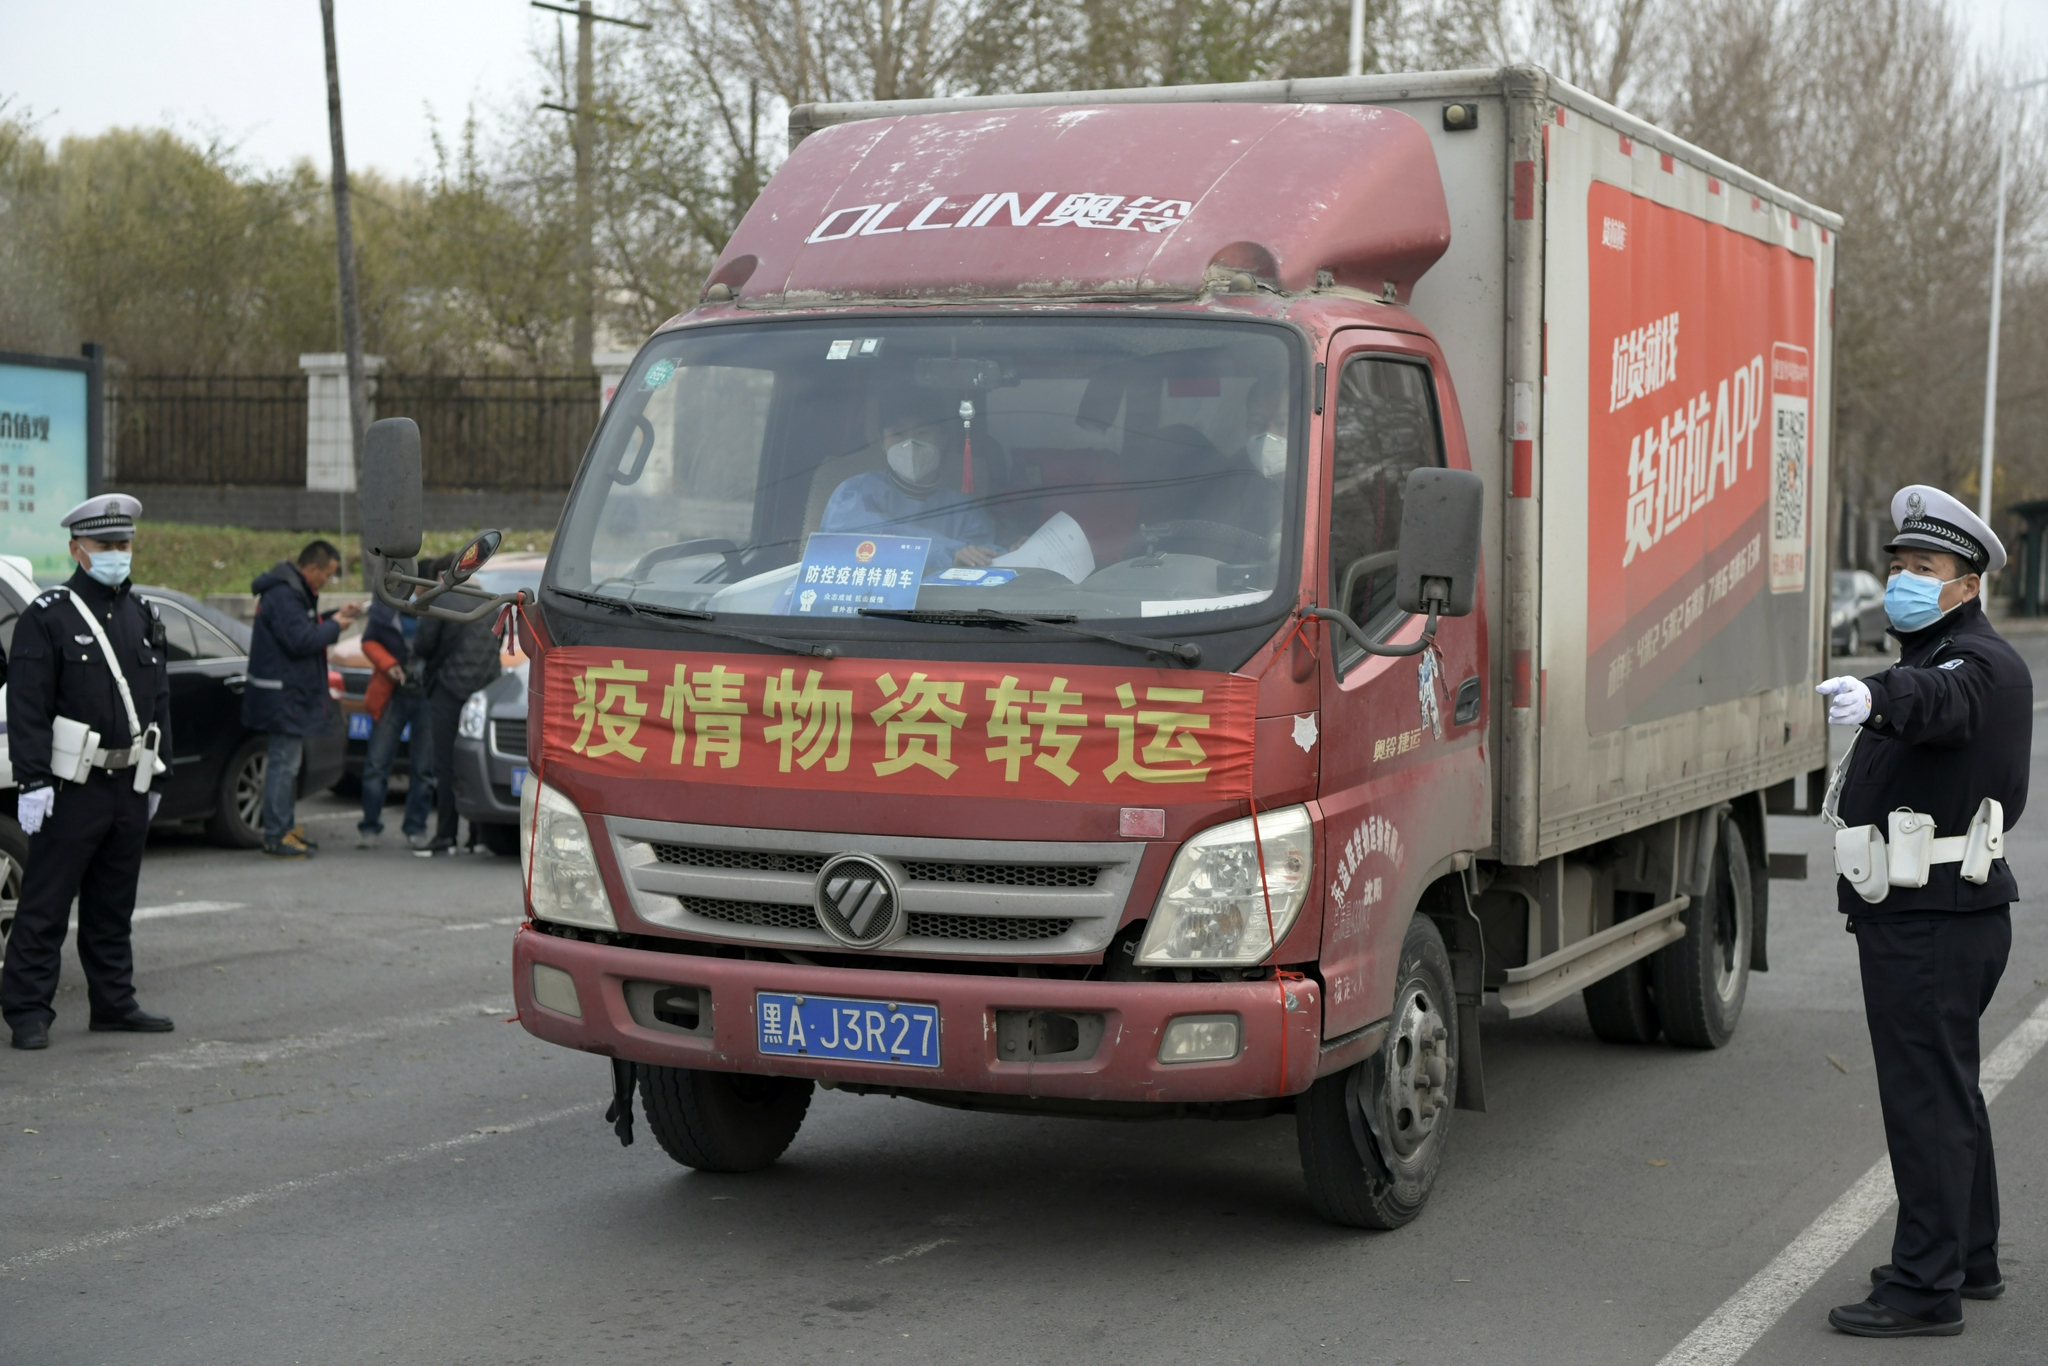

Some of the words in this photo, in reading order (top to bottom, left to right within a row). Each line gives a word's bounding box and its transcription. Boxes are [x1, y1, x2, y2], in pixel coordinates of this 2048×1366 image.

[1609, 311, 1679, 413] 拉货就找
[1622, 354, 1764, 568] 货拉拉APP
[805, 565, 914, 589] 防控疫情特勤车
[831, 605, 867, 614] 道外在行
[570, 659, 1212, 786] 疫情物资转运
[763, 1002, 933, 1057] 黑A·J3R27
